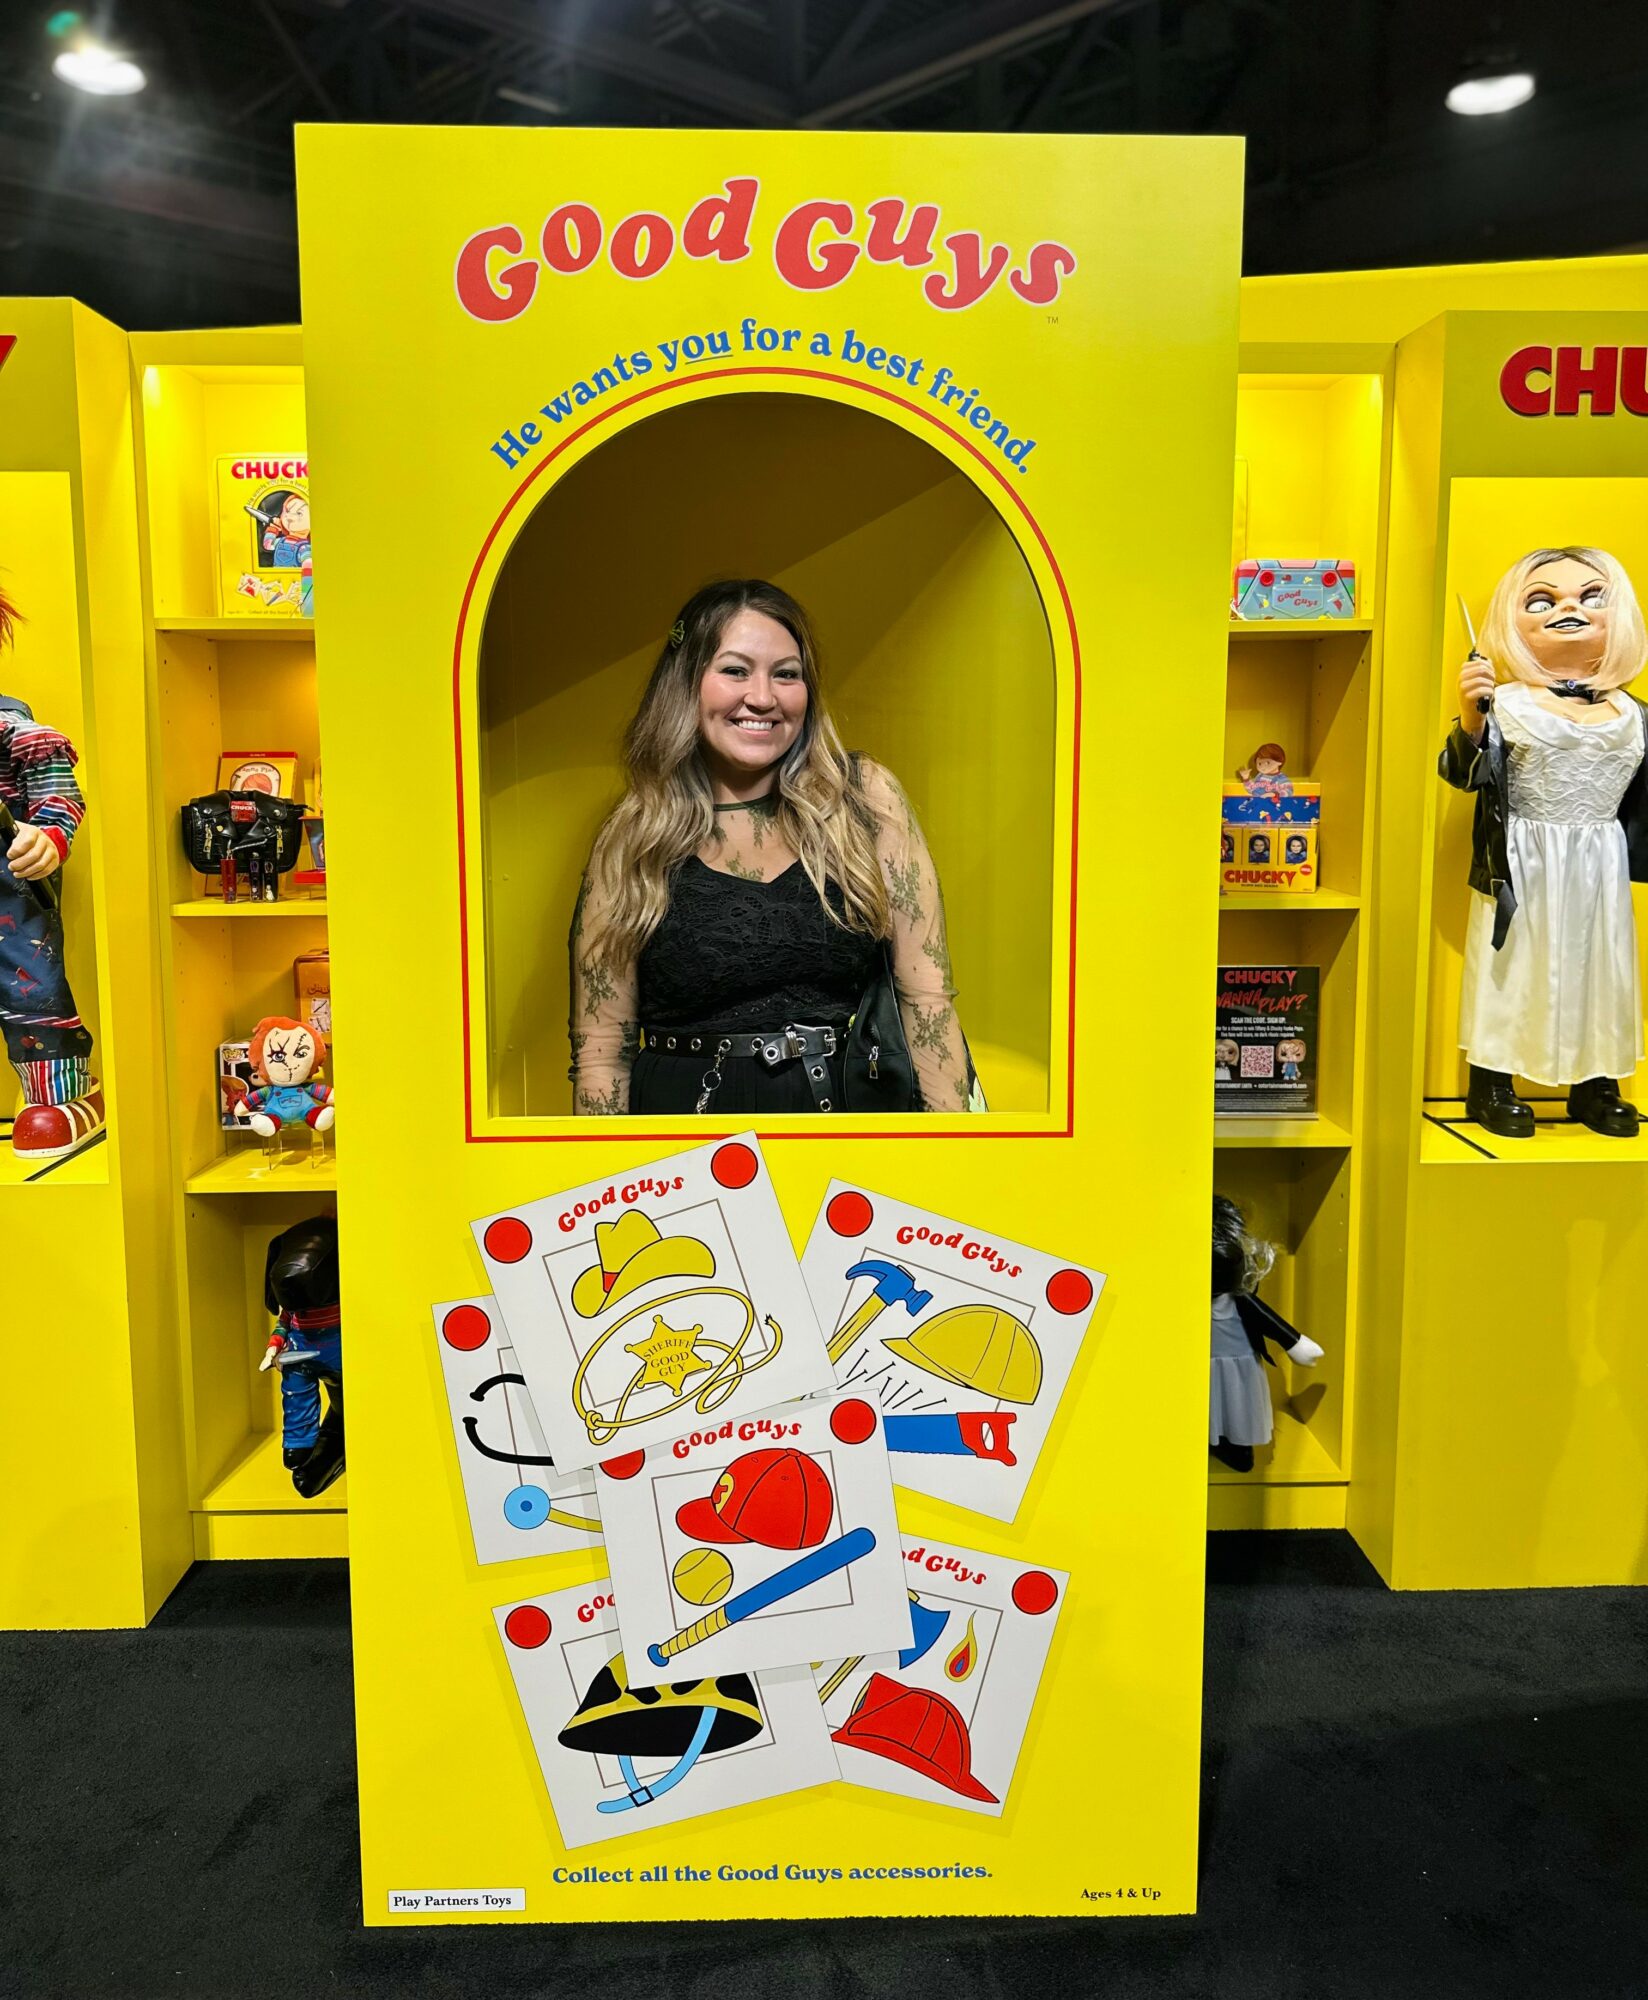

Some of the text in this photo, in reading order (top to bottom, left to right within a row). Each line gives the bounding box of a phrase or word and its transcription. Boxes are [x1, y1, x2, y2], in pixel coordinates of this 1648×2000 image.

[455, 177, 1076, 323] Good Guys
[492, 319, 1036, 474] He wants you for a best friend.
[1277, 589, 1302, 602] Good
[1224, 870, 1297, 888] CHUCKY
[1224, 970, 1297, 991] CHUCKY
[1258, 994, 1308, 1014] PLAY?
[558, 1176, 685, 1233] Good Guys
[896, 1226, 1023, 1278] Good Guys
[643, 1338, 693, 1359] SHERIFF
[650, 1351, 690, 1368] GOOD
[658, 1362, 686, 1377] GUY
[672, 1419, 802, 1459] Good Guys
[925, 1555, 987, 1585] Guys
[552, 1863, 993, 1884] Collect all the Good Guys accessories.
[393, 1895, 511, 1909] Play Partners Toys
[1081, 1888, 1161, 1901] Ages 4 & Up
